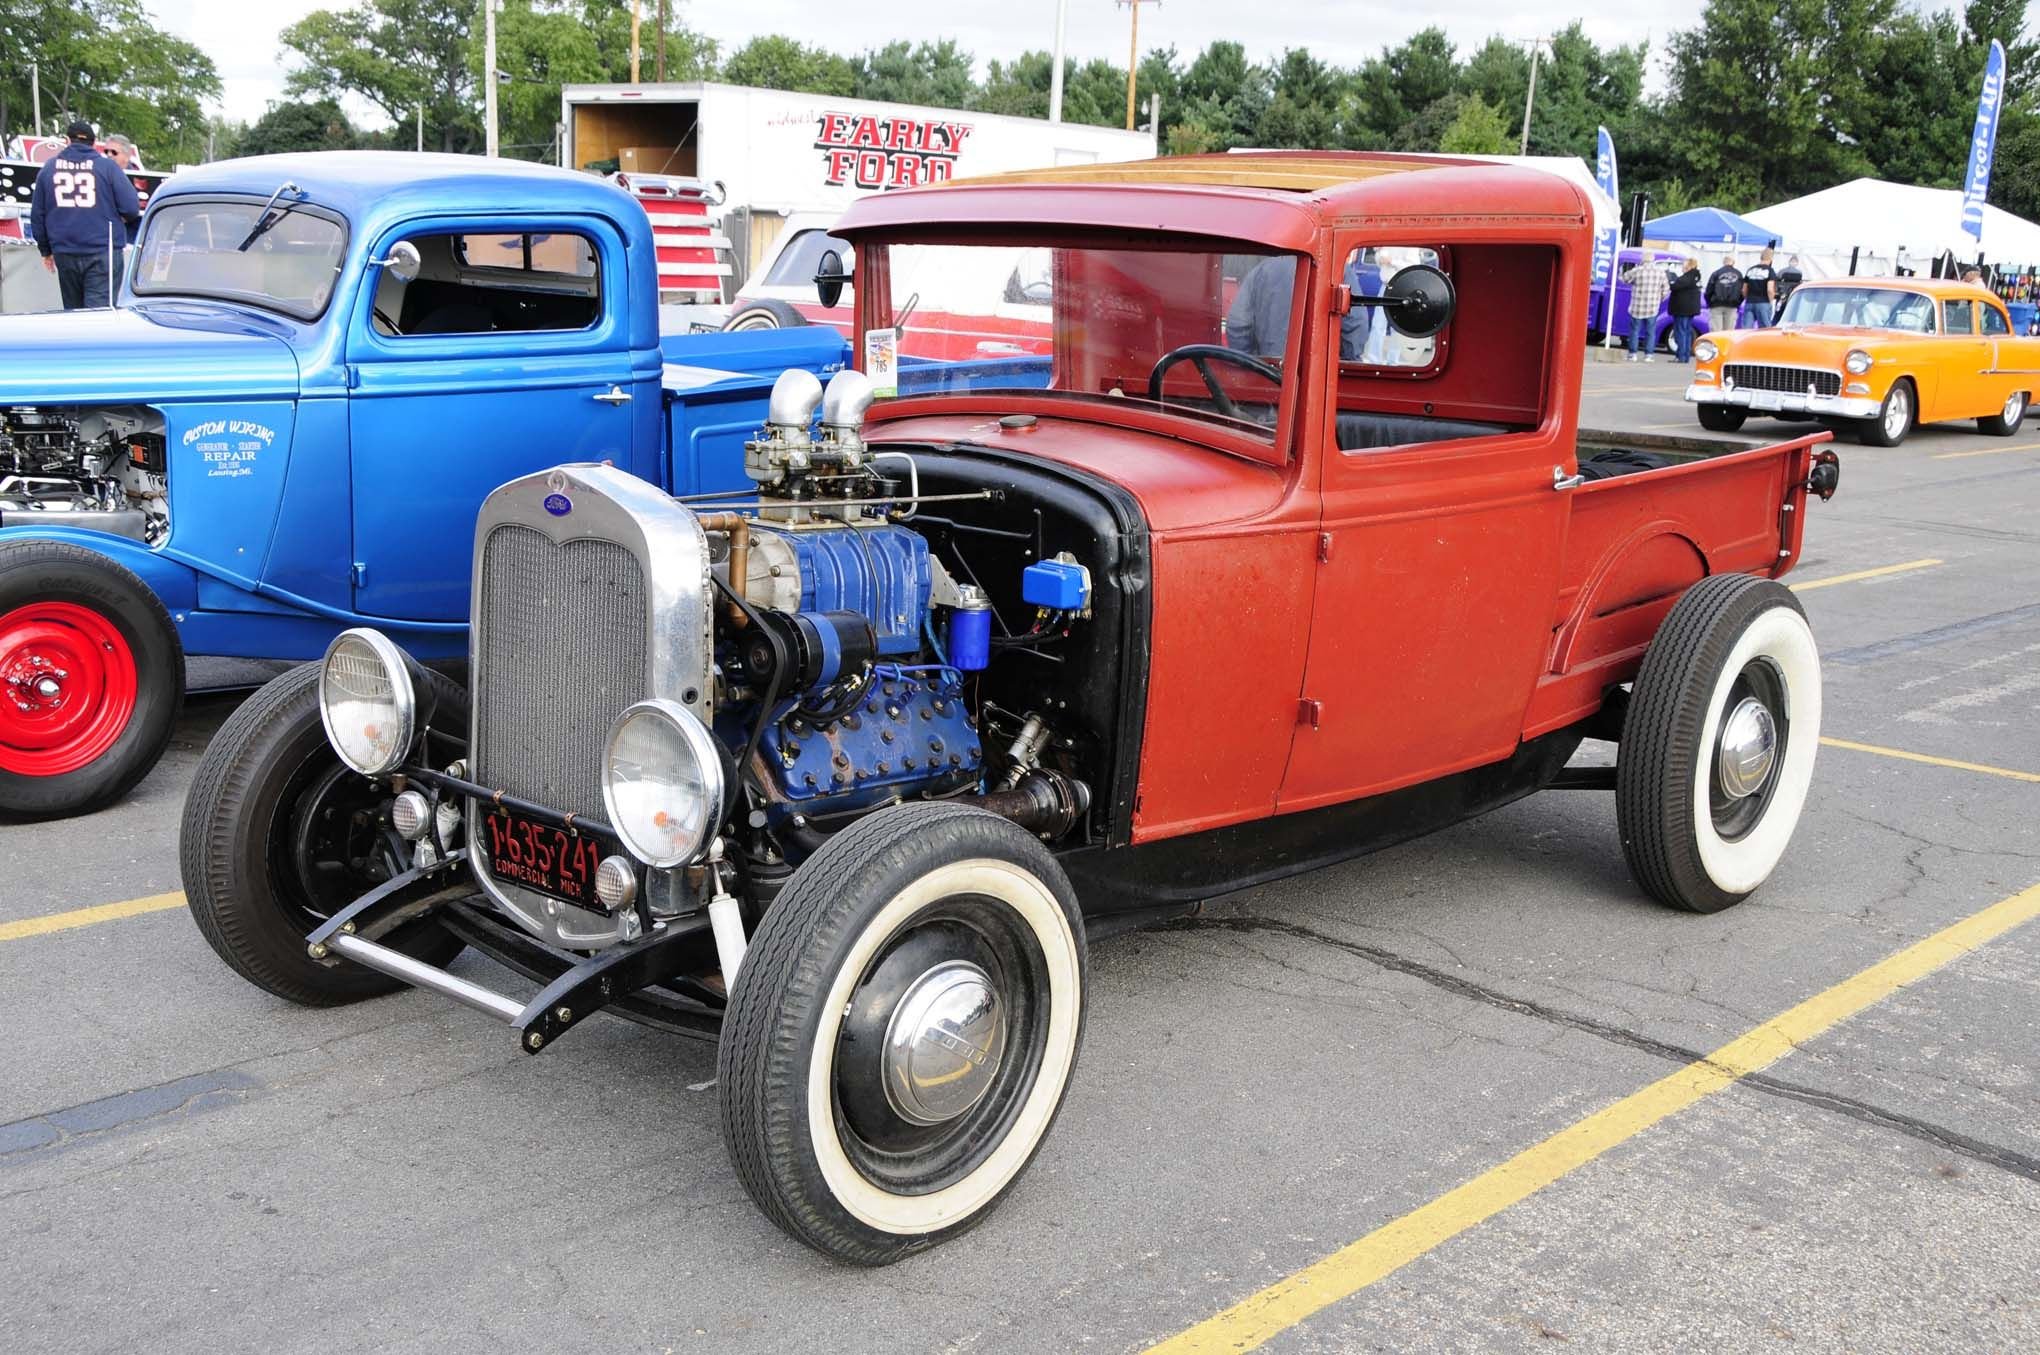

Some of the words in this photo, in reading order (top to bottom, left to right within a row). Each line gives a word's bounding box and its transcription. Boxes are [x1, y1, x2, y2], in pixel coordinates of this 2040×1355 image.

[814, 111, 974, 160] EARLY
[824, 148, 955, 190] FORD
[53, 171, 97, 208] 23
[183, 420, 227, 446] CUSTOM
[229, 420, 275, 447] WIRING
[204, 451, 256, 462] REPAIR
[495, 858, 553, 889] COMMERCIAL
[560, 878, 582, 897] MICH
